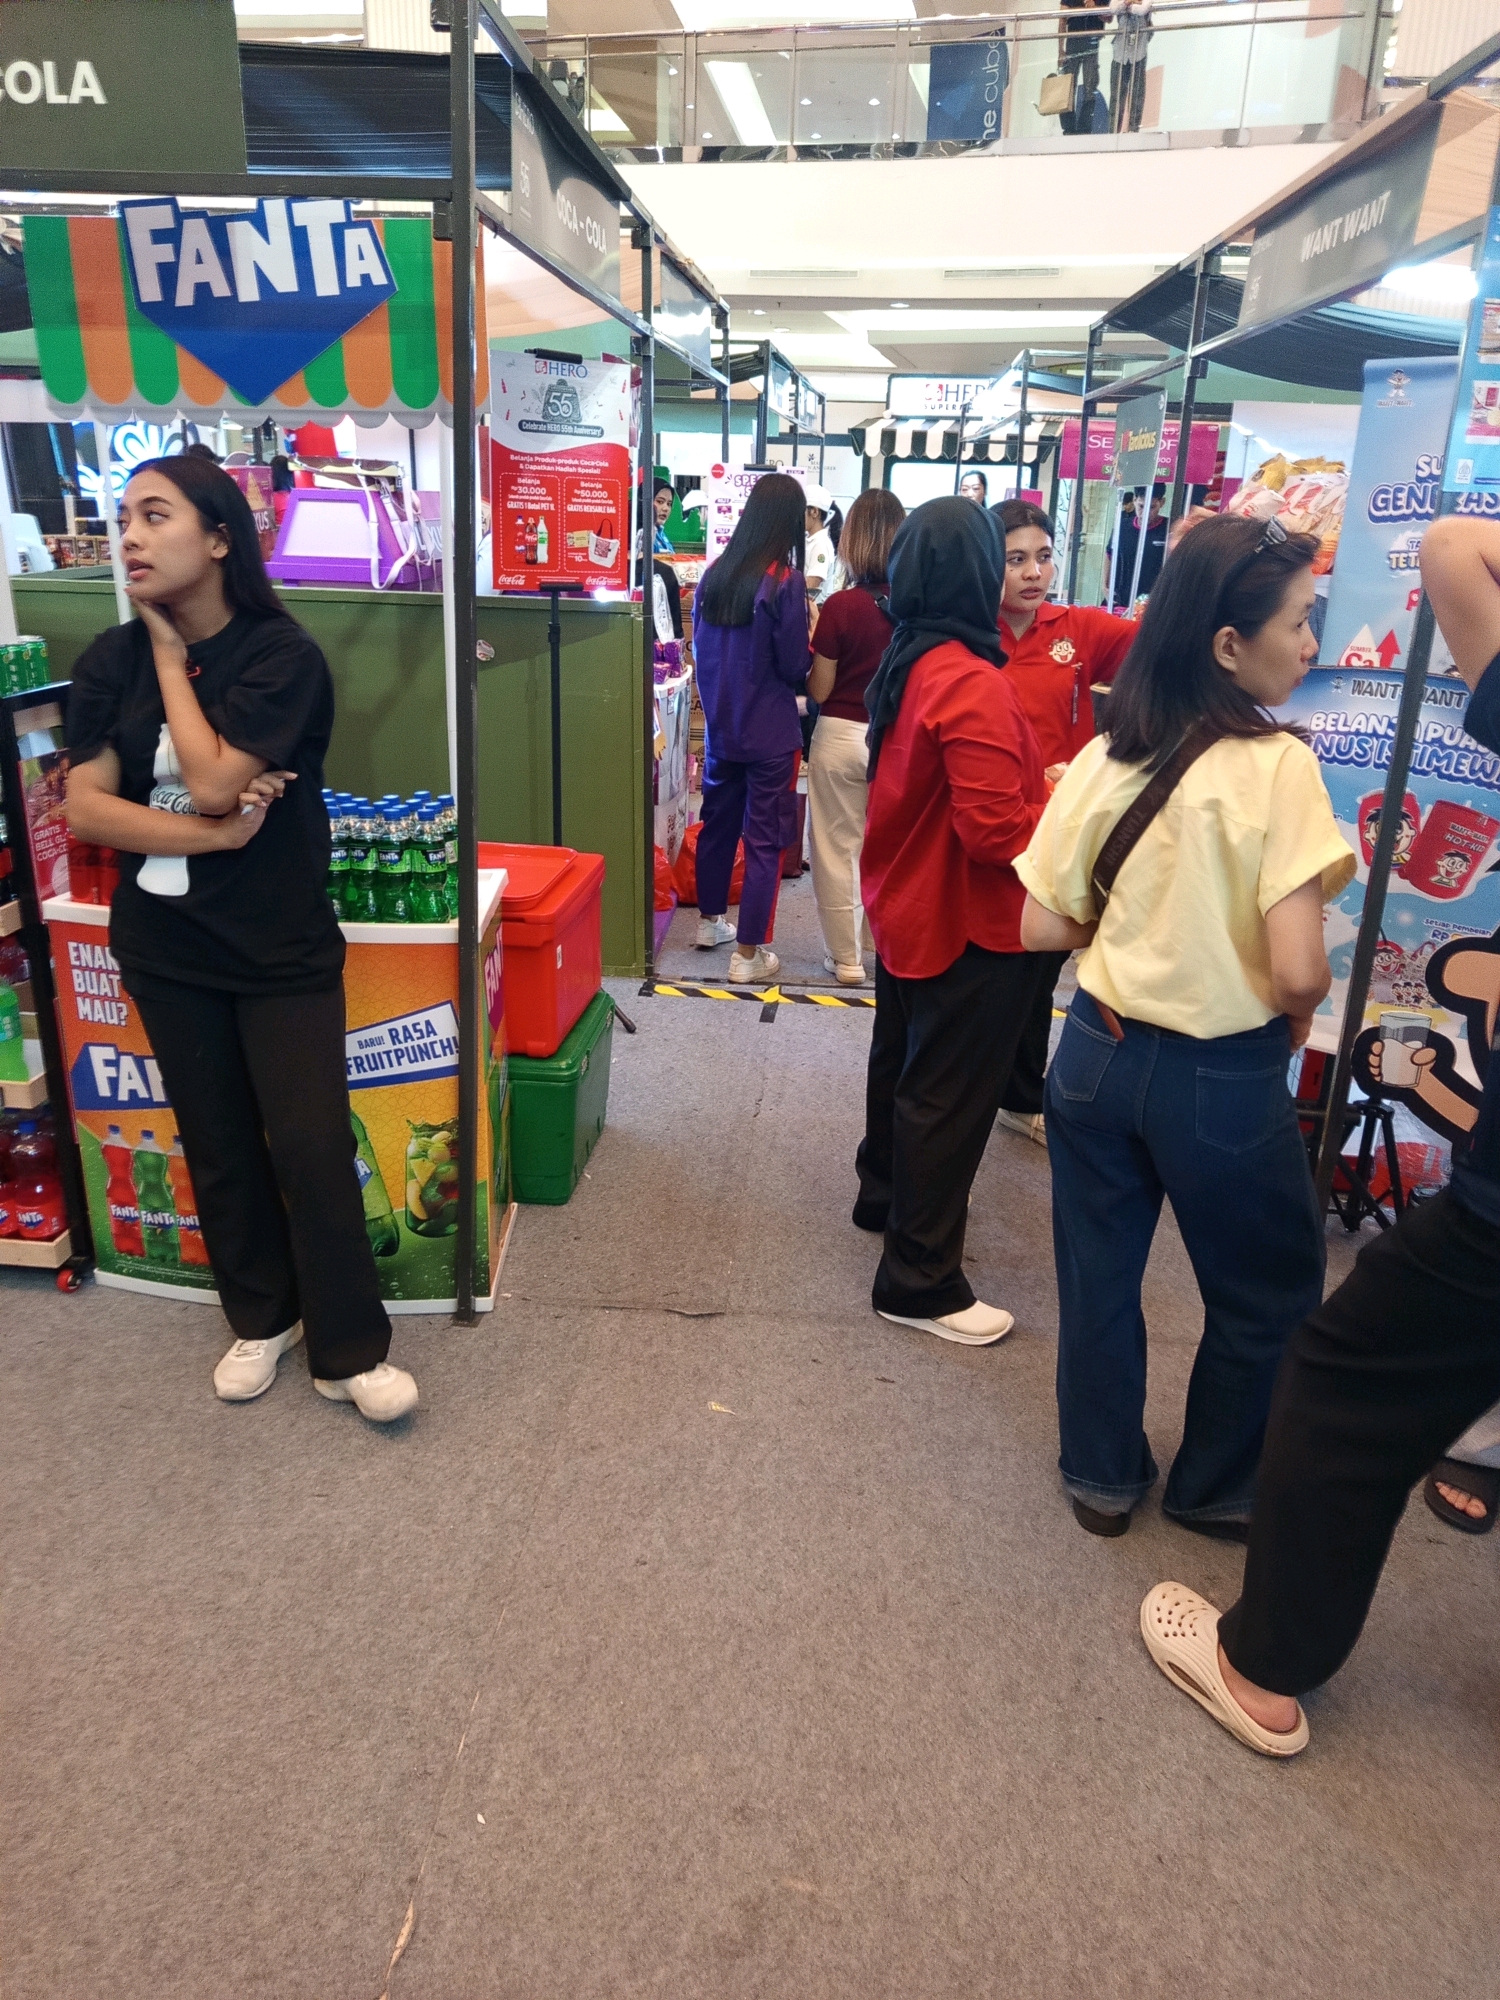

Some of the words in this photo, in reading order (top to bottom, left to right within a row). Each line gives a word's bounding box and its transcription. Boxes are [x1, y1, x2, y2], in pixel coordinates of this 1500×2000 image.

[0, 60, 107, 104] OLA
[556, 188, 579, 236] COCA
[586, 216, 607, 256] COLA
[1301, 217, 1343, 263] WANT
[1343, 190, 1392, 243] WANT
[124, 199, 389, 307] FANTA
[548, 361, 588, 379] HERO
[548, 392, 574, 417] 55
[521, 421, 546, 432] Celebrate
[547, 423, 560, 432] HERO
[561, 424, 573, 434] 55th
[510, 454, 534, 464] Belanja
[1417, 454, 1444, 477] SU
[525, 464, 554, 473] Dapatkan
[555, 466, 577, 474] Hadiah
[517, 478, 540, 486] Belanja
[580, 481, 602, 489] Belanja
[511, 486, 547, 496] Rp30.000
[574, 489, 608, 498] Rp50.000
[507, 501, 524, 510] GRATIS
[567, 504, 583, 512] GRATIS
[1390, 553, 1420, 569] TET
[1349, 645, 1373, 653] SUMBER
[34, 826, 61, 841] GRATIS
[331, 849, 347, 858] ANTA
[72, 969, 121, 998] BUAT
[76, 997, 128, 1026] MAU?
[357, 1035, 385, 1050] BARU!
[388, 1019, 438, 1047] RASA
[110, 1204, 139, 1218] FANTA
[141, 1210, 175, 1225] FANTA
[176, 1214, 200, 1227] FANT
